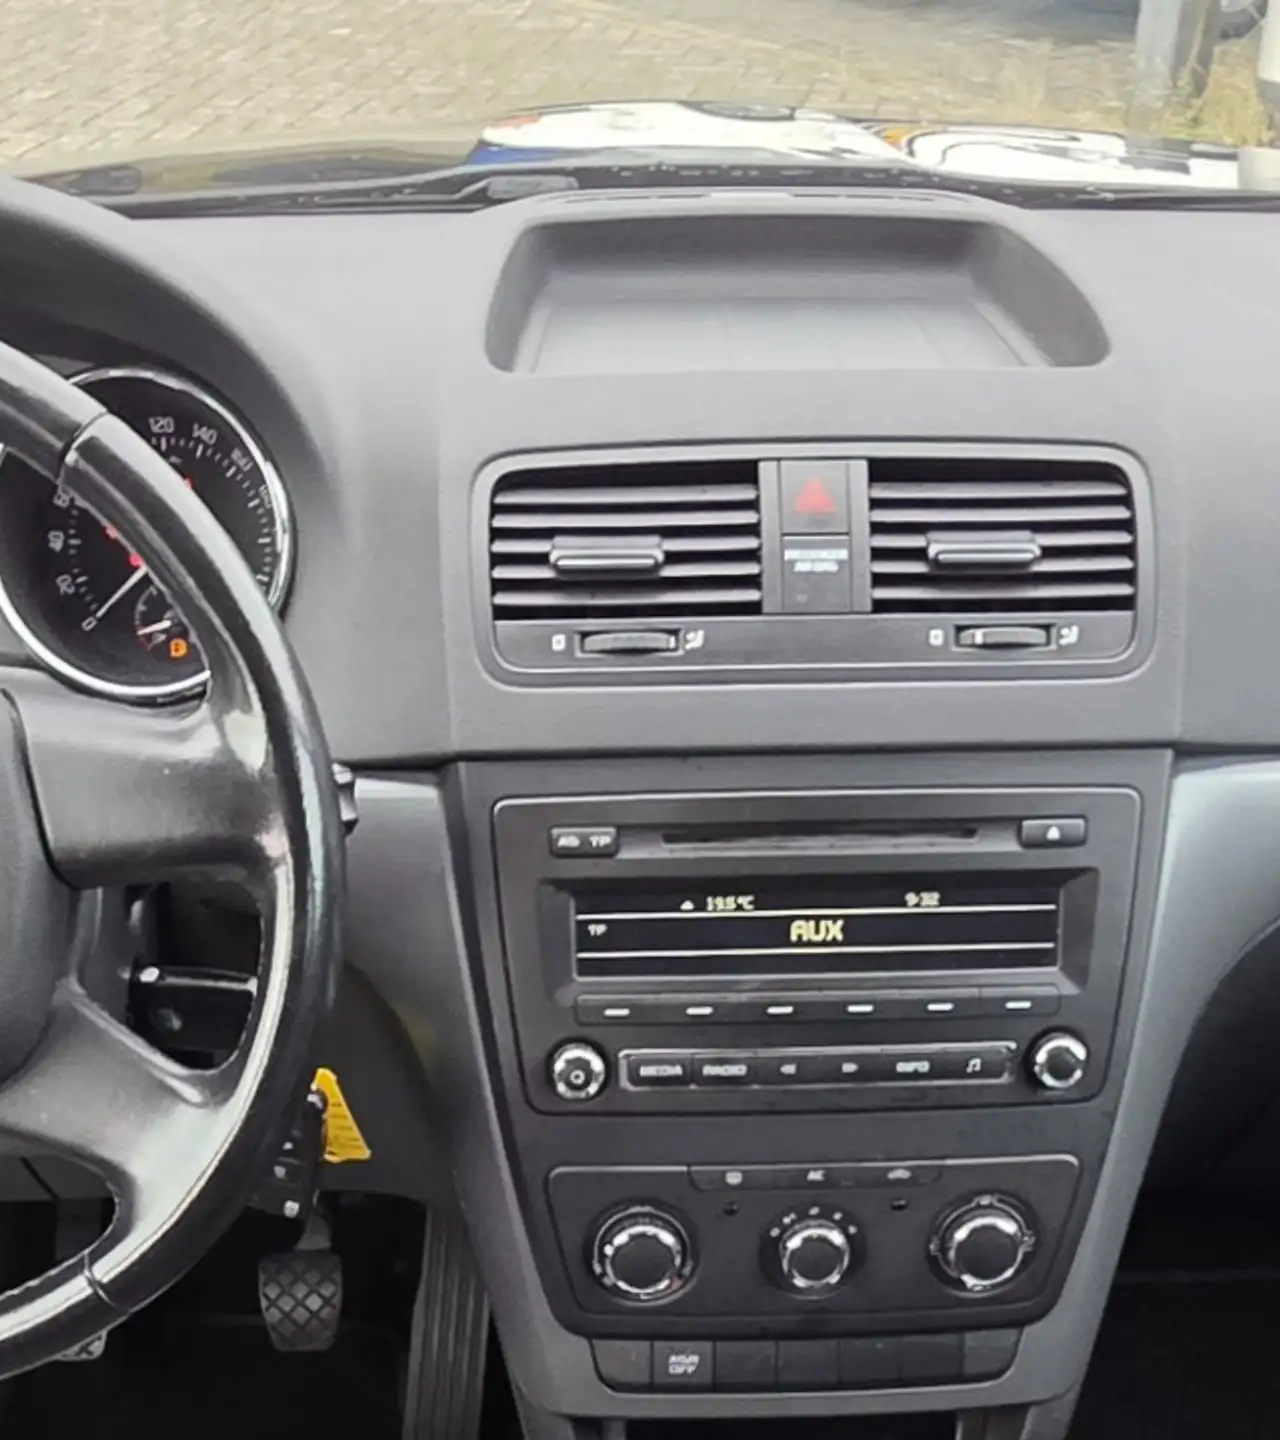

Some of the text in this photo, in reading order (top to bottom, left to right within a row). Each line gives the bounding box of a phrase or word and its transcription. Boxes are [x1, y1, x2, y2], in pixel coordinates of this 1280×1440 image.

[148, 416, 175, 433] 120
[192, 422, 218, 444] 140
[48, 530, 65, 552] 40
[56, 574, 76, 596] 20
[81, 616, 97, 632] 0
[589, 835, 613, 848] TP
[588, 923, 608, 937] TP
[789, 919, 844, 942] AUX
